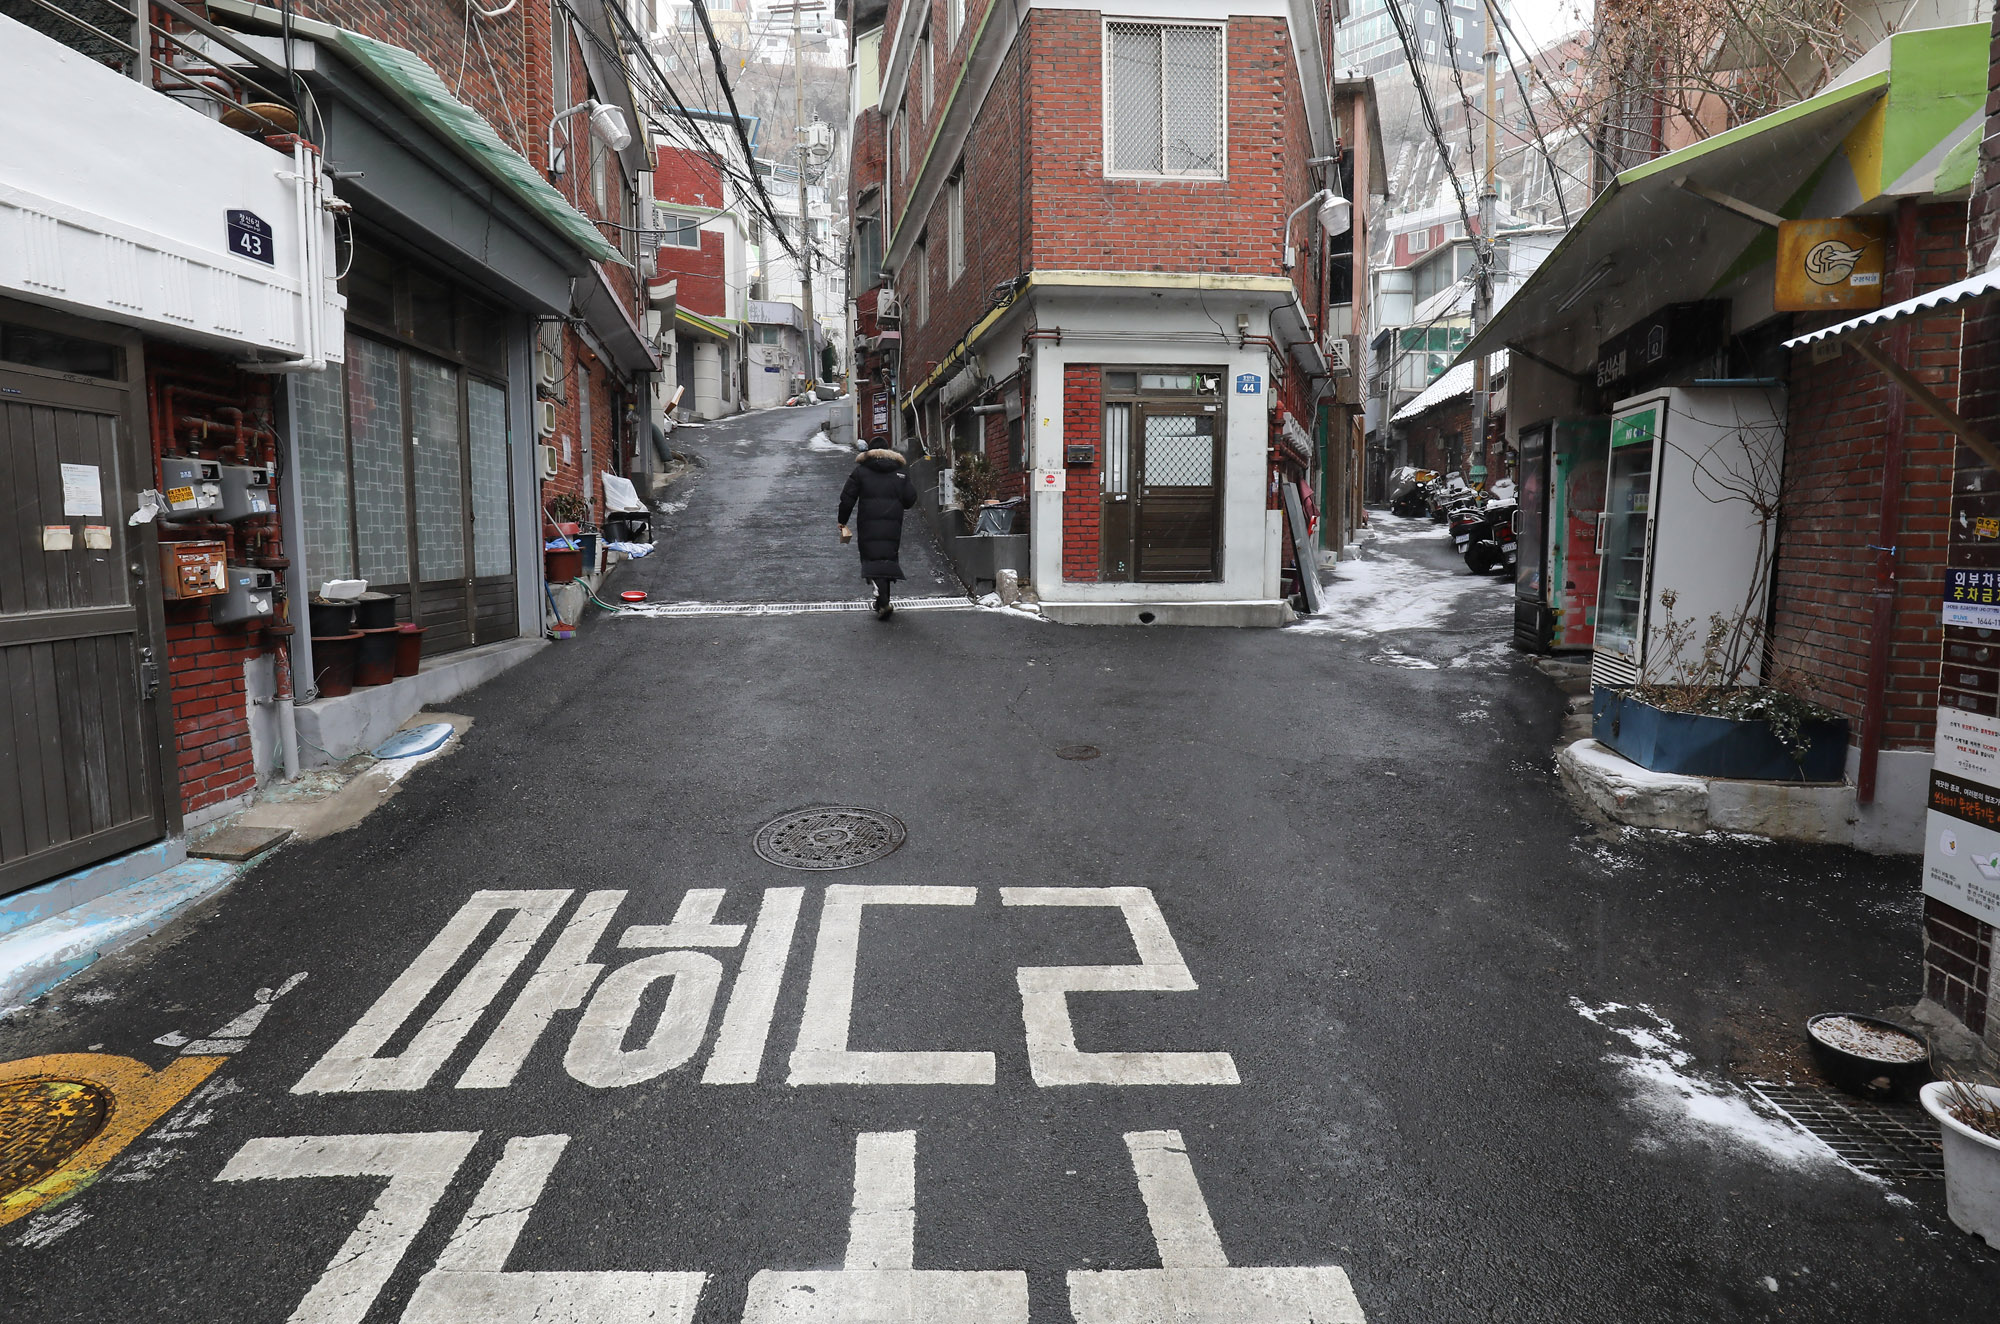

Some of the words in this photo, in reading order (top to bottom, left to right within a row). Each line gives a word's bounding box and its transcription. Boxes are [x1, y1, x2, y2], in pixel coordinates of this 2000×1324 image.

[241, 233, 262, 255] 43
[1242, 384, 1255, 393] 44
[1935, 780, 1949, 790] 깨끗한
[1963, 788, 1984, 801] 여러분의
[1934, 791, 1957, 808] 쓰레기
[1959, 797, 1995, 824] 무단투기는
